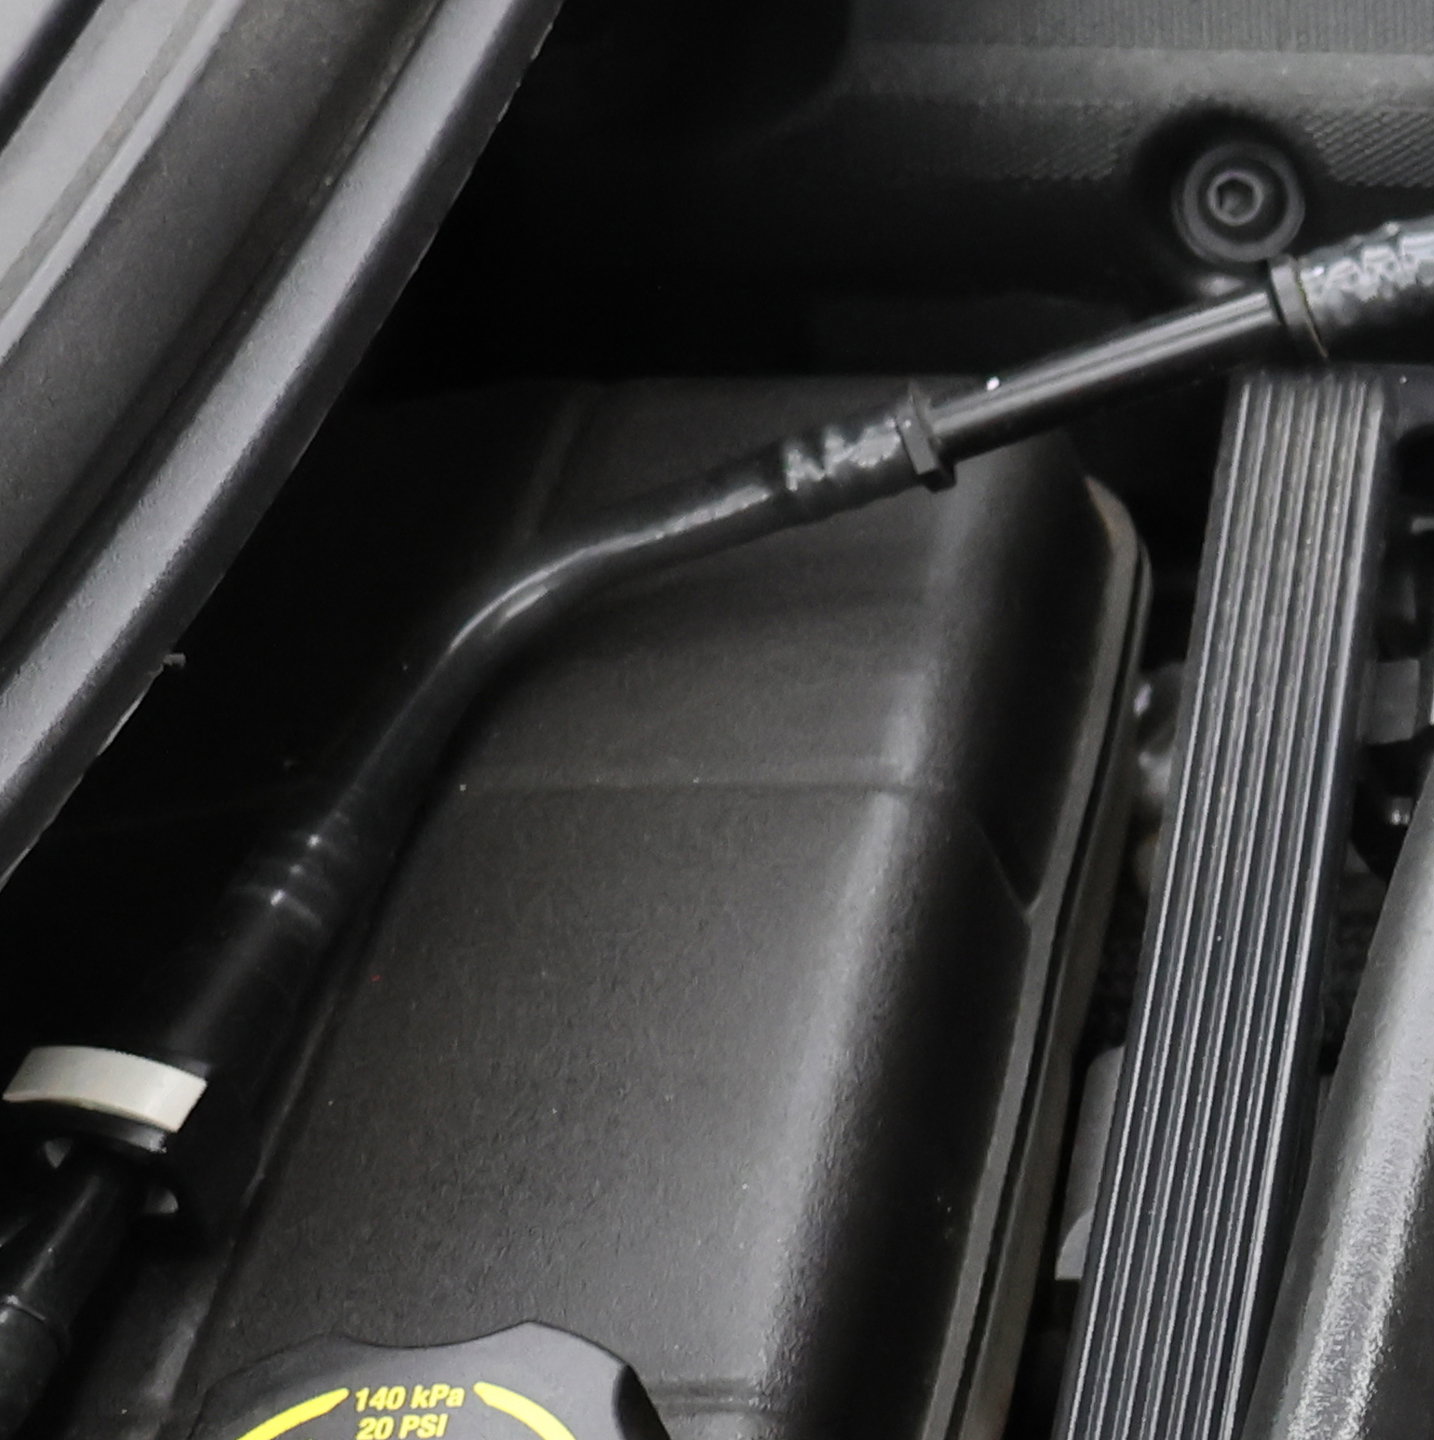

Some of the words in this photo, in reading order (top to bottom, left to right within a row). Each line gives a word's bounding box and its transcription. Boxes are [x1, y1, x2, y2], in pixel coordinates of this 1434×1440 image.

[355, 1385, 407, 1412] 140
[410, 1383, 465, 1409] kPa
[398, 1413, 449, 1440] PSI
